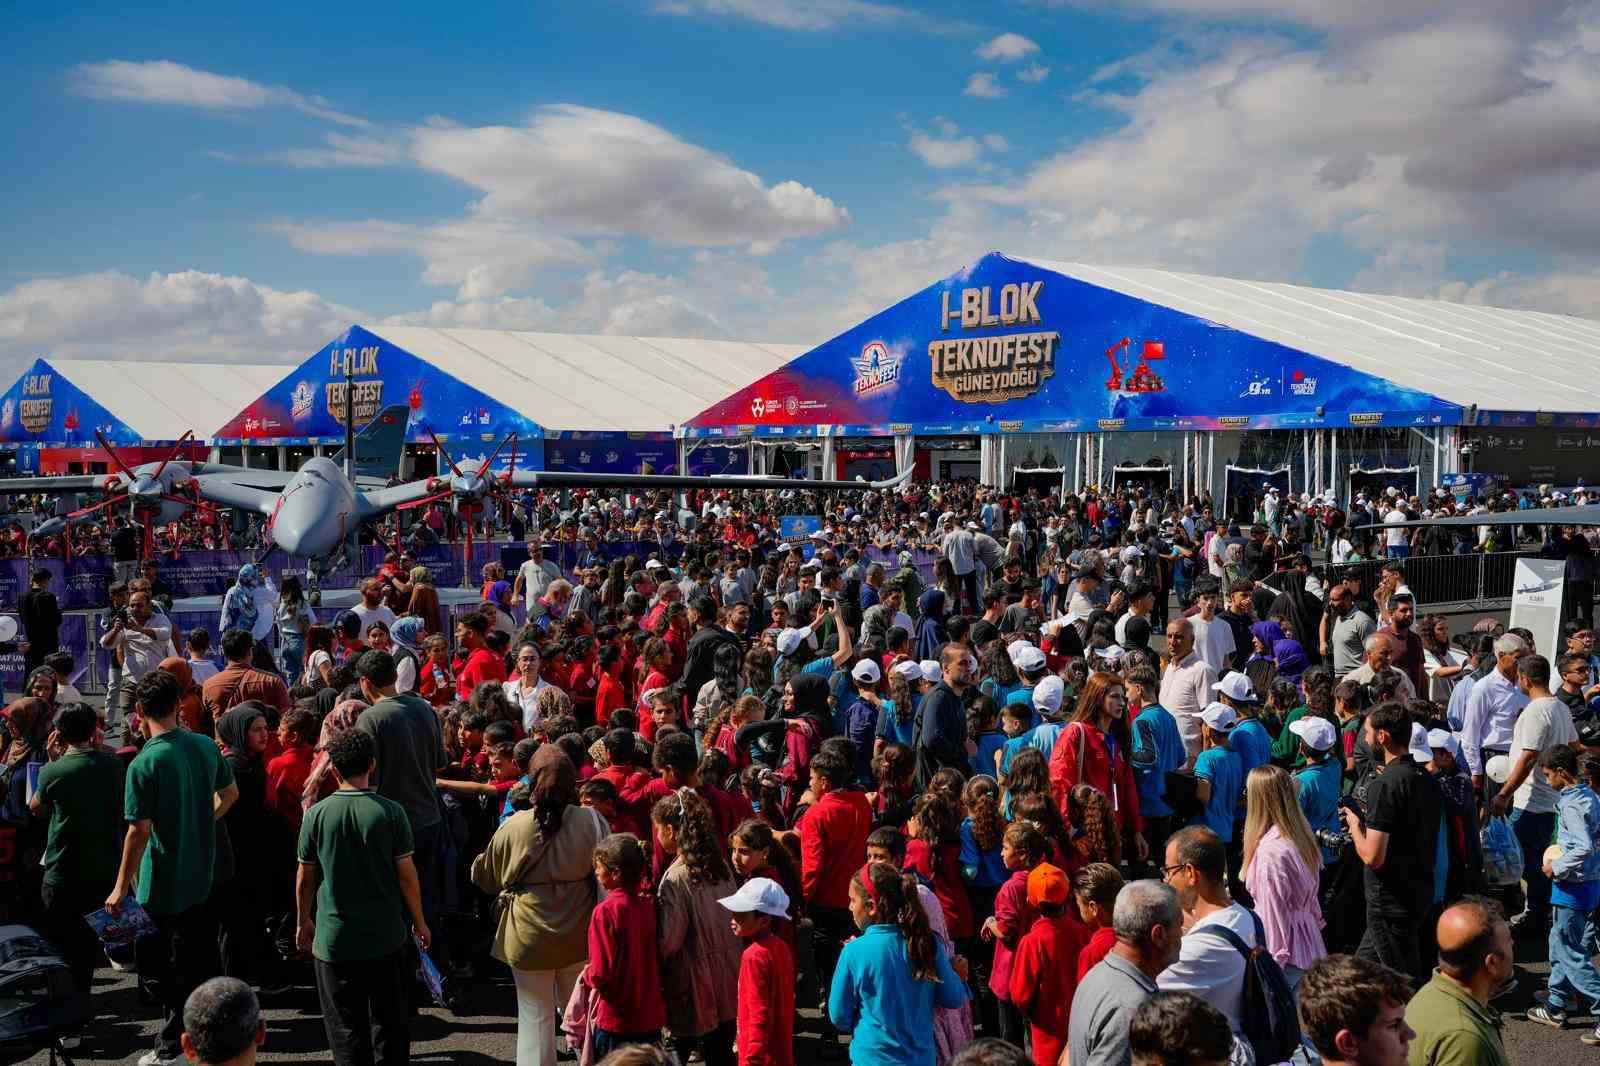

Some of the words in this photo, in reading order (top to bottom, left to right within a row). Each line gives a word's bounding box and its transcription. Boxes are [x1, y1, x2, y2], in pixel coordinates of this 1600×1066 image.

[941, 281, 1044, 330] I-BLOK
[929, 332, 1059, 375] TEKNOFEST
[326, 381, 384, 405] TEKOFEST
[856, 360, 899, 393] TEKNOFEST
[954, 366, 1037, 393] GÜNEYDOĞU
